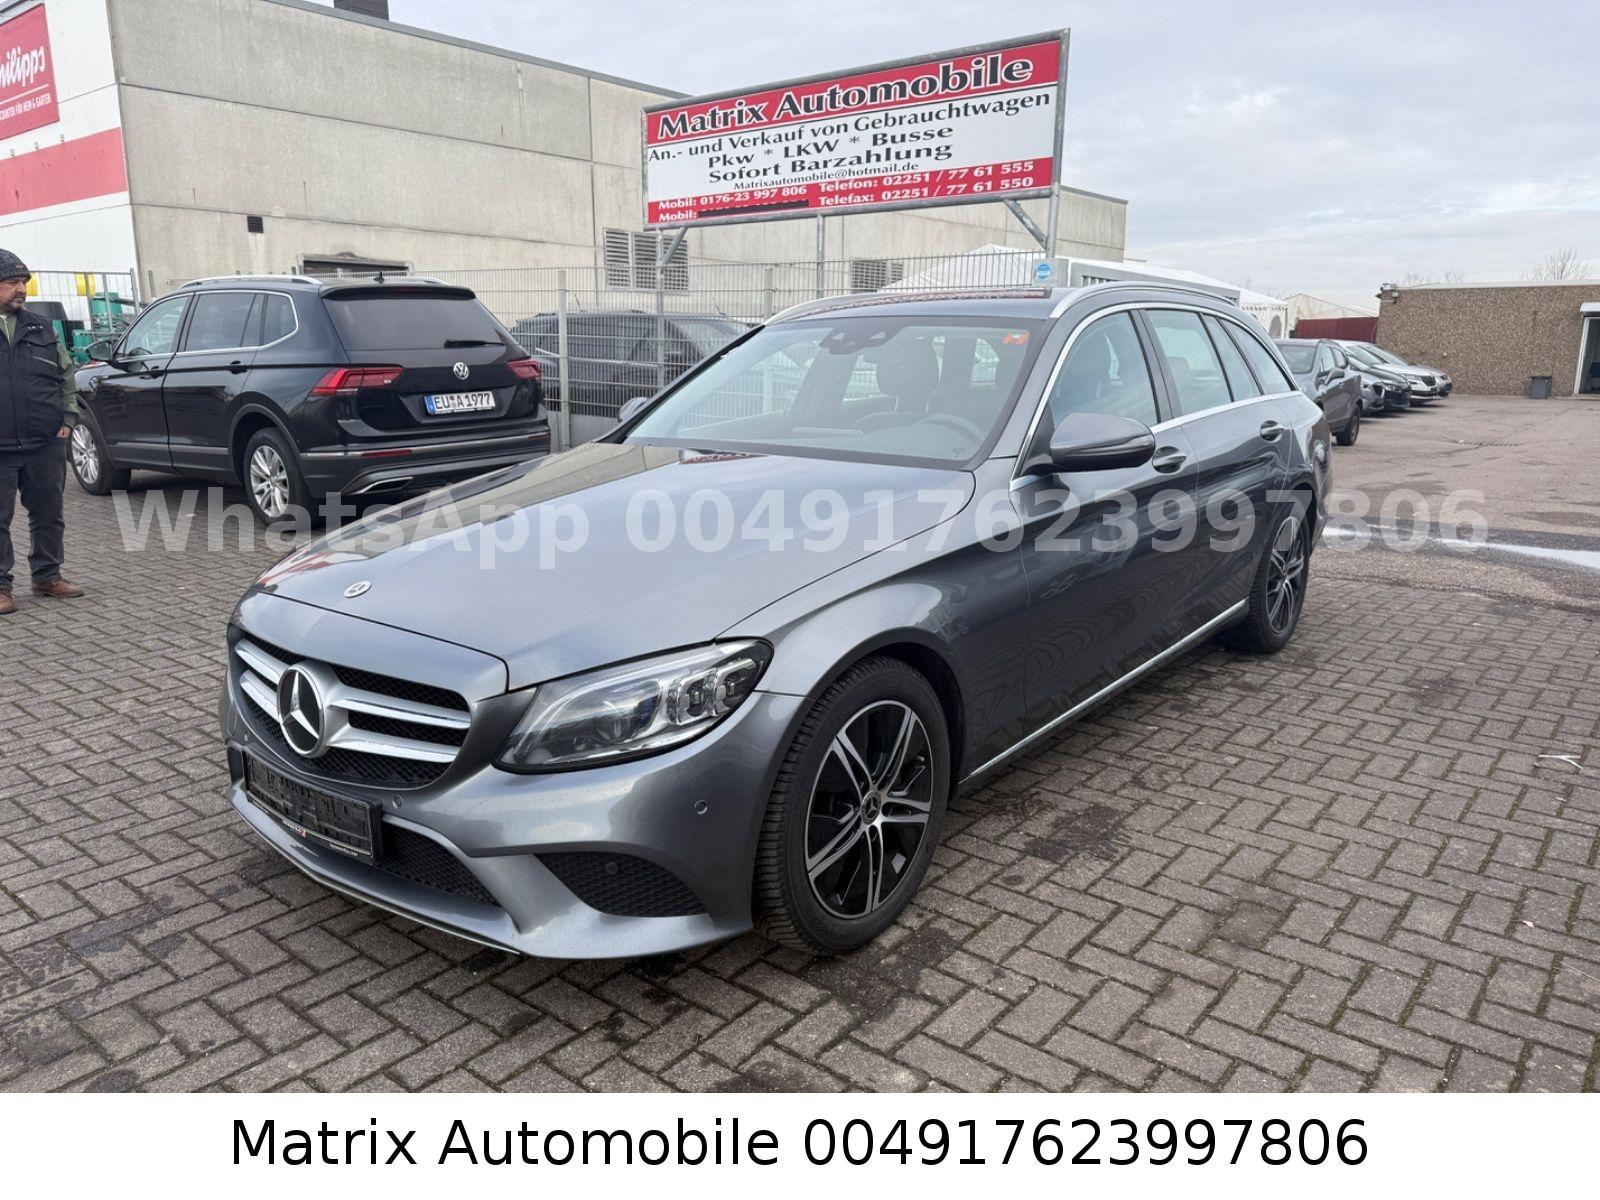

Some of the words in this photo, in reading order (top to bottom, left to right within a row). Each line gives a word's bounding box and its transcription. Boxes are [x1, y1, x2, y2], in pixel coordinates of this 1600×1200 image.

[658, 100, 769, 139] Matrix
[773, 54, 1034, 121] Automobile
[649, 149, 683, 162] An.-
[689, 138, 722, 156] und
[729, 125, 805, 150] Verkauf
[811, 122, 848, 136] von
[854, 93, 1050, 132] Gebrauchtwagen
[708, 153, 755, 169] Pkw
[784, 138, 840, 159] LKW
[872, 126, 954, 147] Busse
[708, 162, 782, 184] Sofort
[791, 143, 953, 173] Barzahlung
[733, 162, 919, 190] Matrixautomobile@hotmail.de
[819, 179, 878, 193] Telefon:
[882, 172, 930, 186] 02251
[948, 169, 970, 180] 77
[973, 166, 993, 177] 61
[1000, 161, 1034, 174] 555
[658, 197, 697, 210] Mobil:
[700, 190, 750, 206] 0176-23
[753, 188, 778, 200] 997
[781, 185, 808, 196] 806
[818, 193, 875, 207] Telefax:
[881, 187, 929, 201] 02251
[946, 184, 968, 195] 77
[972, 181, 993, 192] 61
[1000, 176, 1034, 190] 550
[658, 208, 698, 221] Mobil:
[434, 396, 450, 410] EU
